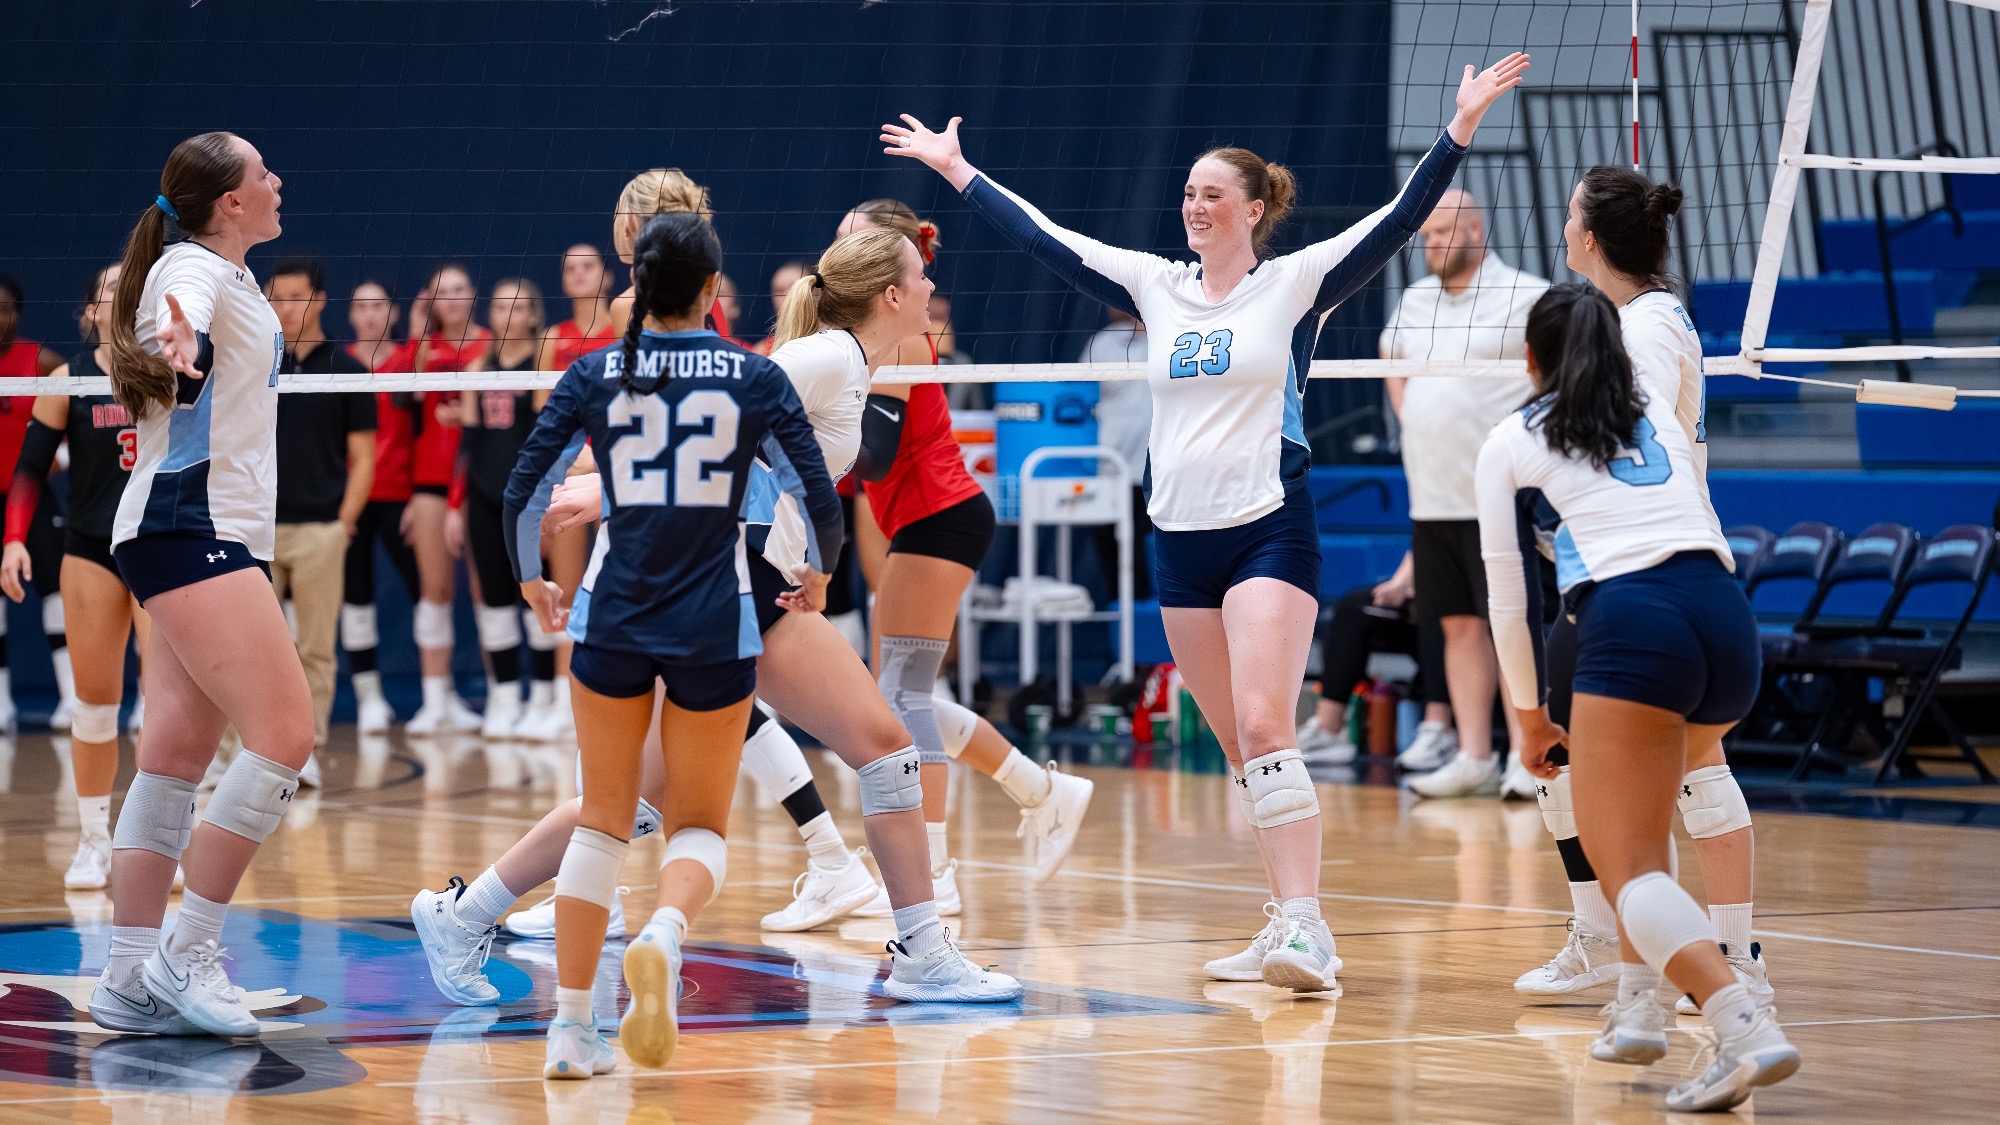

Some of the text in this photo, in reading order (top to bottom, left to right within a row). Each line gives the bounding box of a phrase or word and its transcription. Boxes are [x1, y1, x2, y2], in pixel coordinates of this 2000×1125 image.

[603, 348, 746, 380] EMHURST
[1169, 328, 1234, 379] 23
[92, 404, 134, 429] RHO
[116, 428, 138, 472] 3
[606, 389, 741, 508] 22
